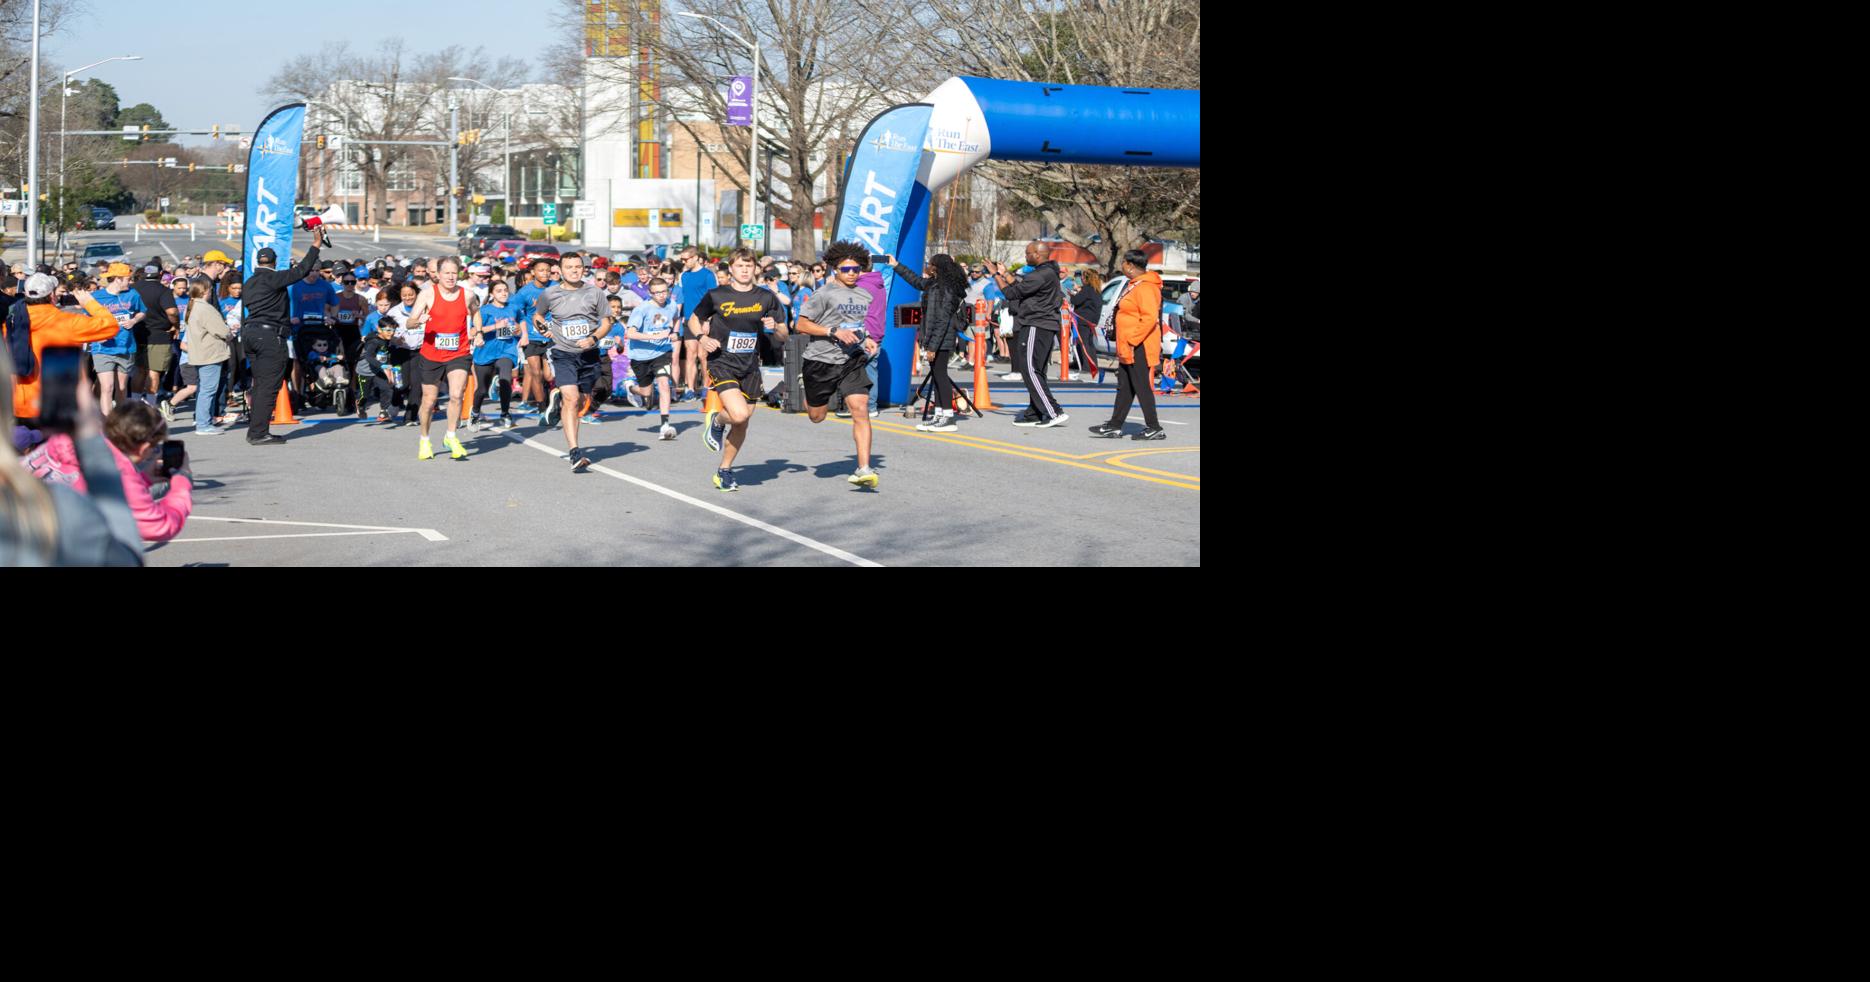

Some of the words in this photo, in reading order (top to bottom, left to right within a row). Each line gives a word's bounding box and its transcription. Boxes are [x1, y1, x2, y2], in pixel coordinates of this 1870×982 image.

[936, 138, 957, 149] The
[958, 140, 979, 153] East
[854, 169, 897, 255] ART
[837, 303, 867, 312] AYDEN
[565, 324, 588, 337] 1838
[439, 337, 460, 347] 2018
[730, 338, 756, 350] 1892
